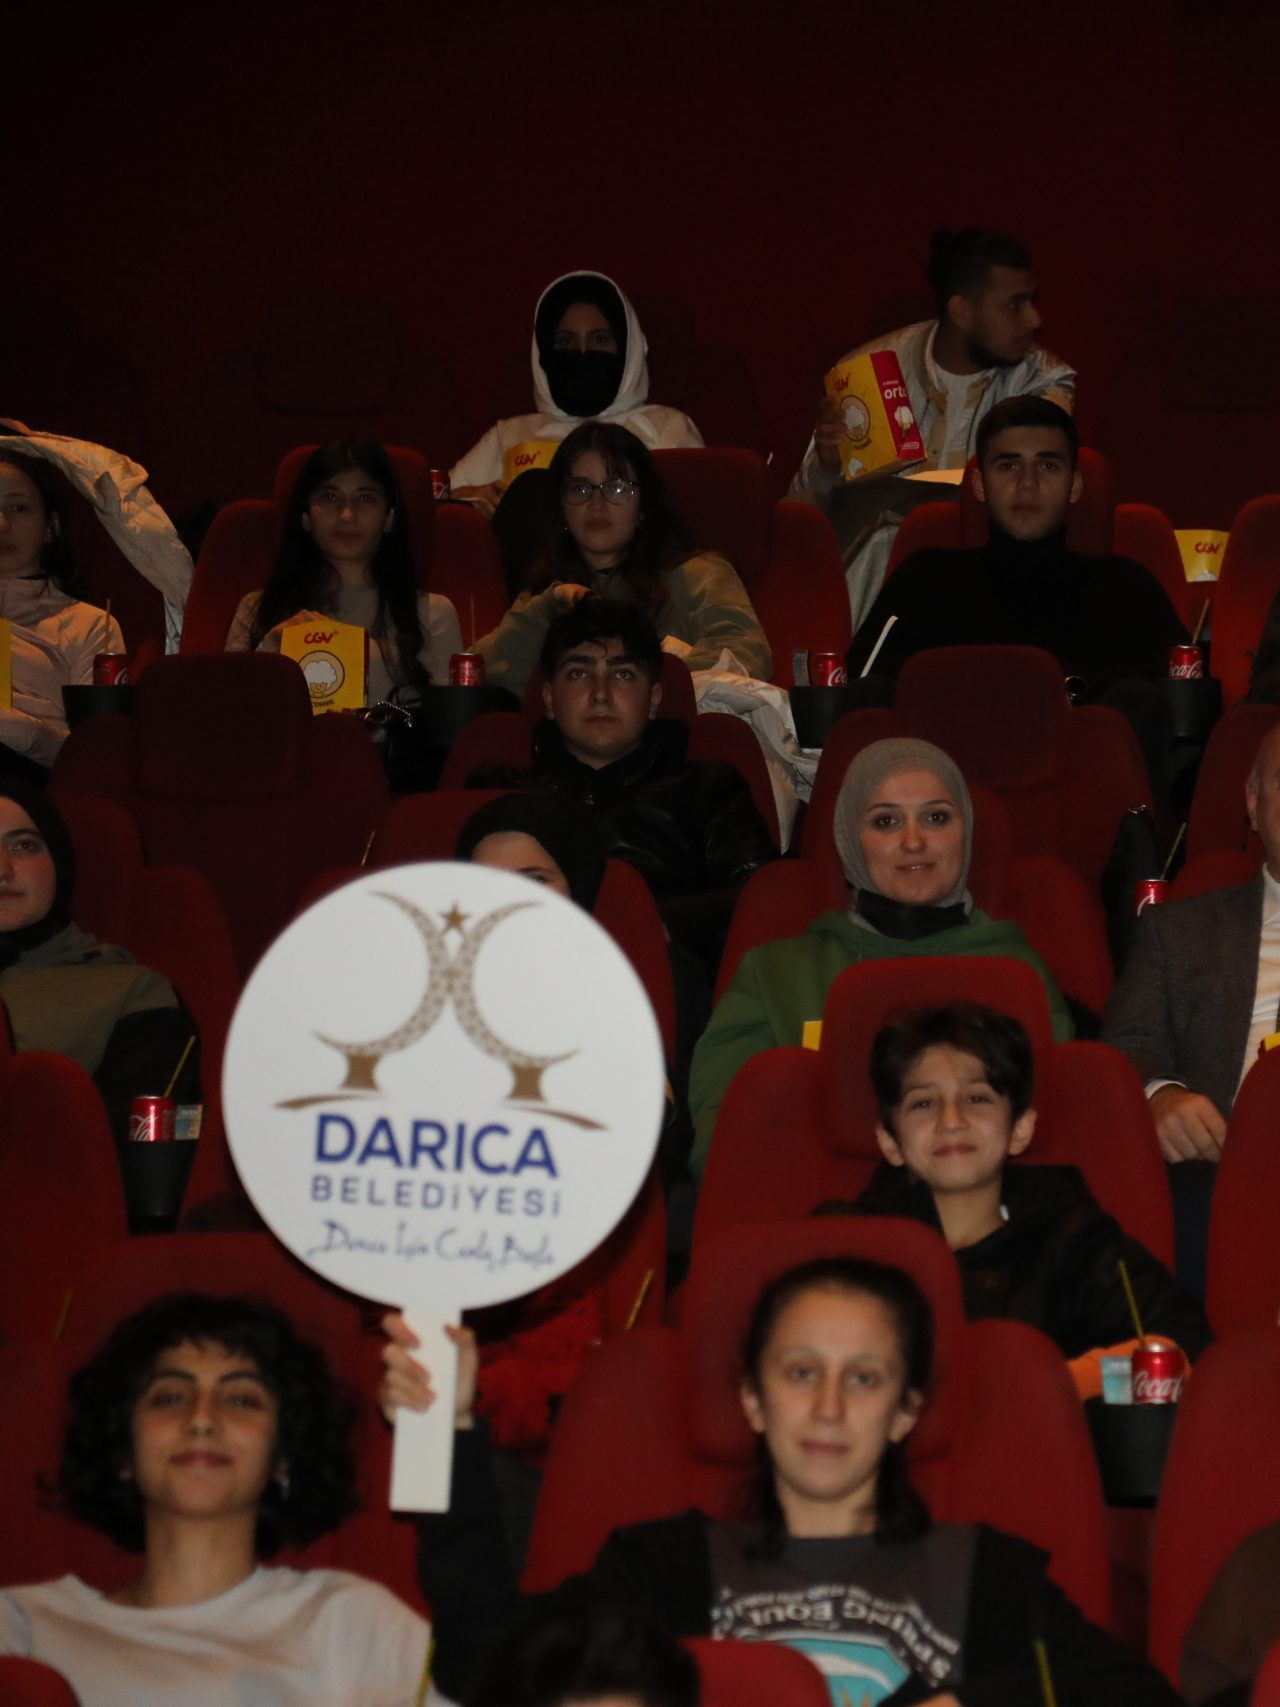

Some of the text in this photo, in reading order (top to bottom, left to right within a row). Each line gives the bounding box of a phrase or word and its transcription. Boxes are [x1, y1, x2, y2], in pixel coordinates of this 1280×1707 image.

[1195, 542, 1220, 554] CGV
[304, 631, 334, 645] CGV
[315, 1114, 559, 1178] DARICA
